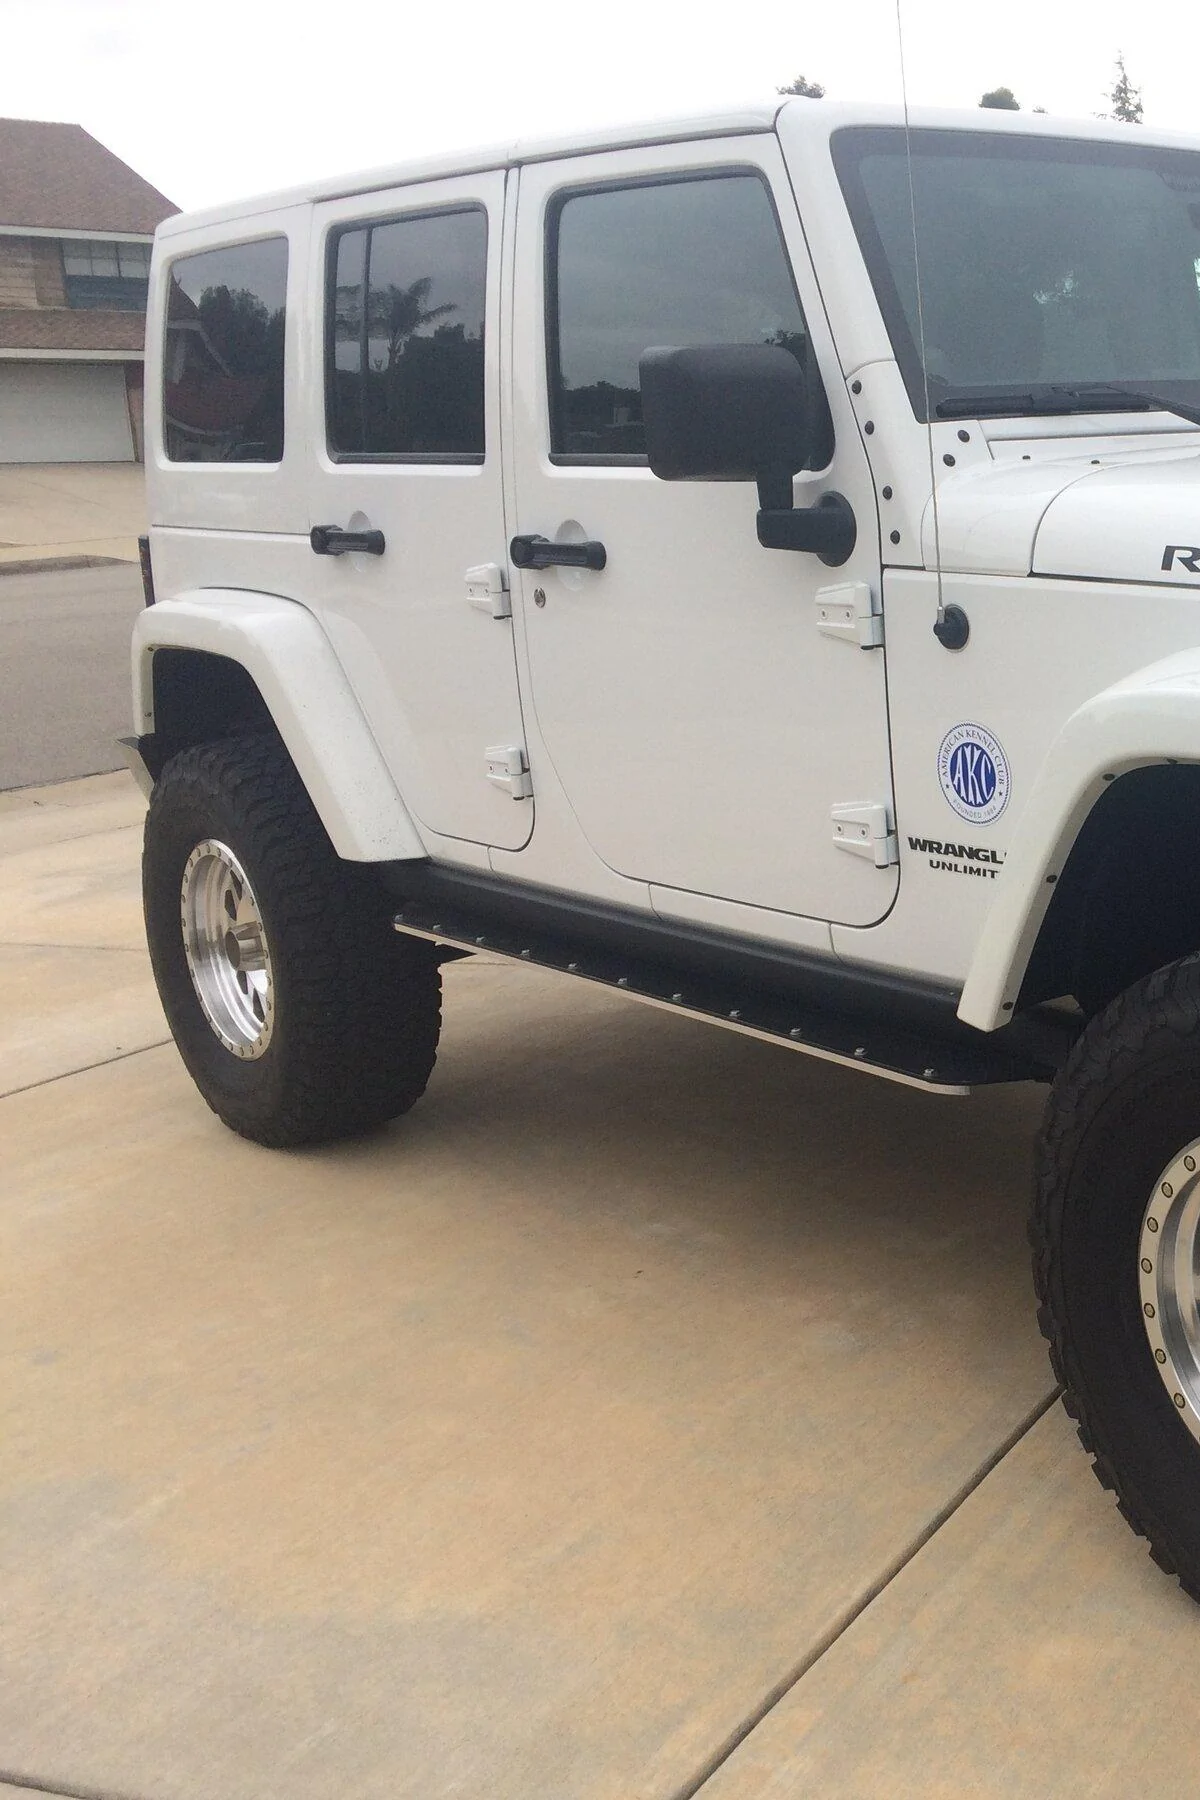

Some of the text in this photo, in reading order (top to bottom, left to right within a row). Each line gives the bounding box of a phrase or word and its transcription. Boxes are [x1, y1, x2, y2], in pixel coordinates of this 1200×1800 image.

[942, 729, 1005, 785] AMERICAN KENNEL CLUB
[953, 743, 995, 805] AKC
[908, 836, 1006, 864] WRANGL
[929, 859, 999, 879] UNLIMIT
